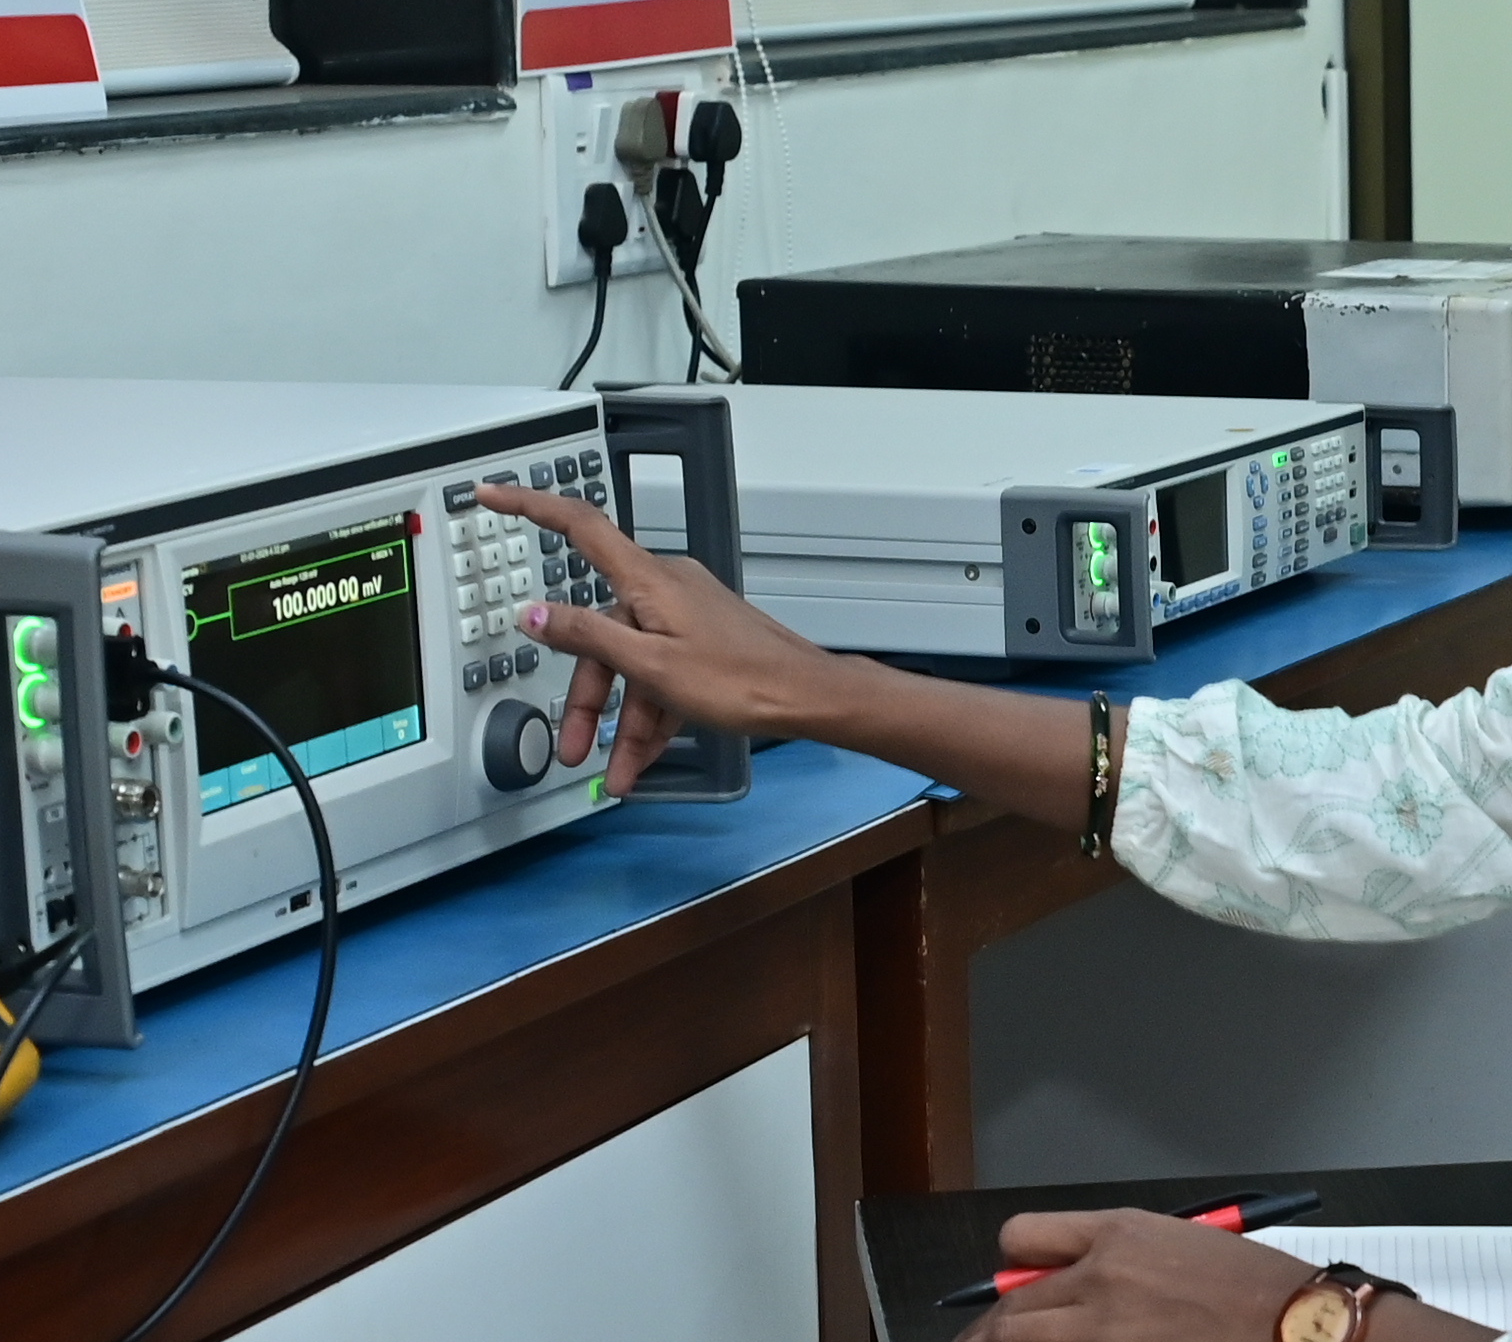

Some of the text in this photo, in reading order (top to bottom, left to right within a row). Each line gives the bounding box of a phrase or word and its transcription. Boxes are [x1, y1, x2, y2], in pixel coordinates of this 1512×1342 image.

[453, 486, 476, 503] OPERAT
[272, 580, 337, 622] 100.000
[362, 573, 383, 598] mV
